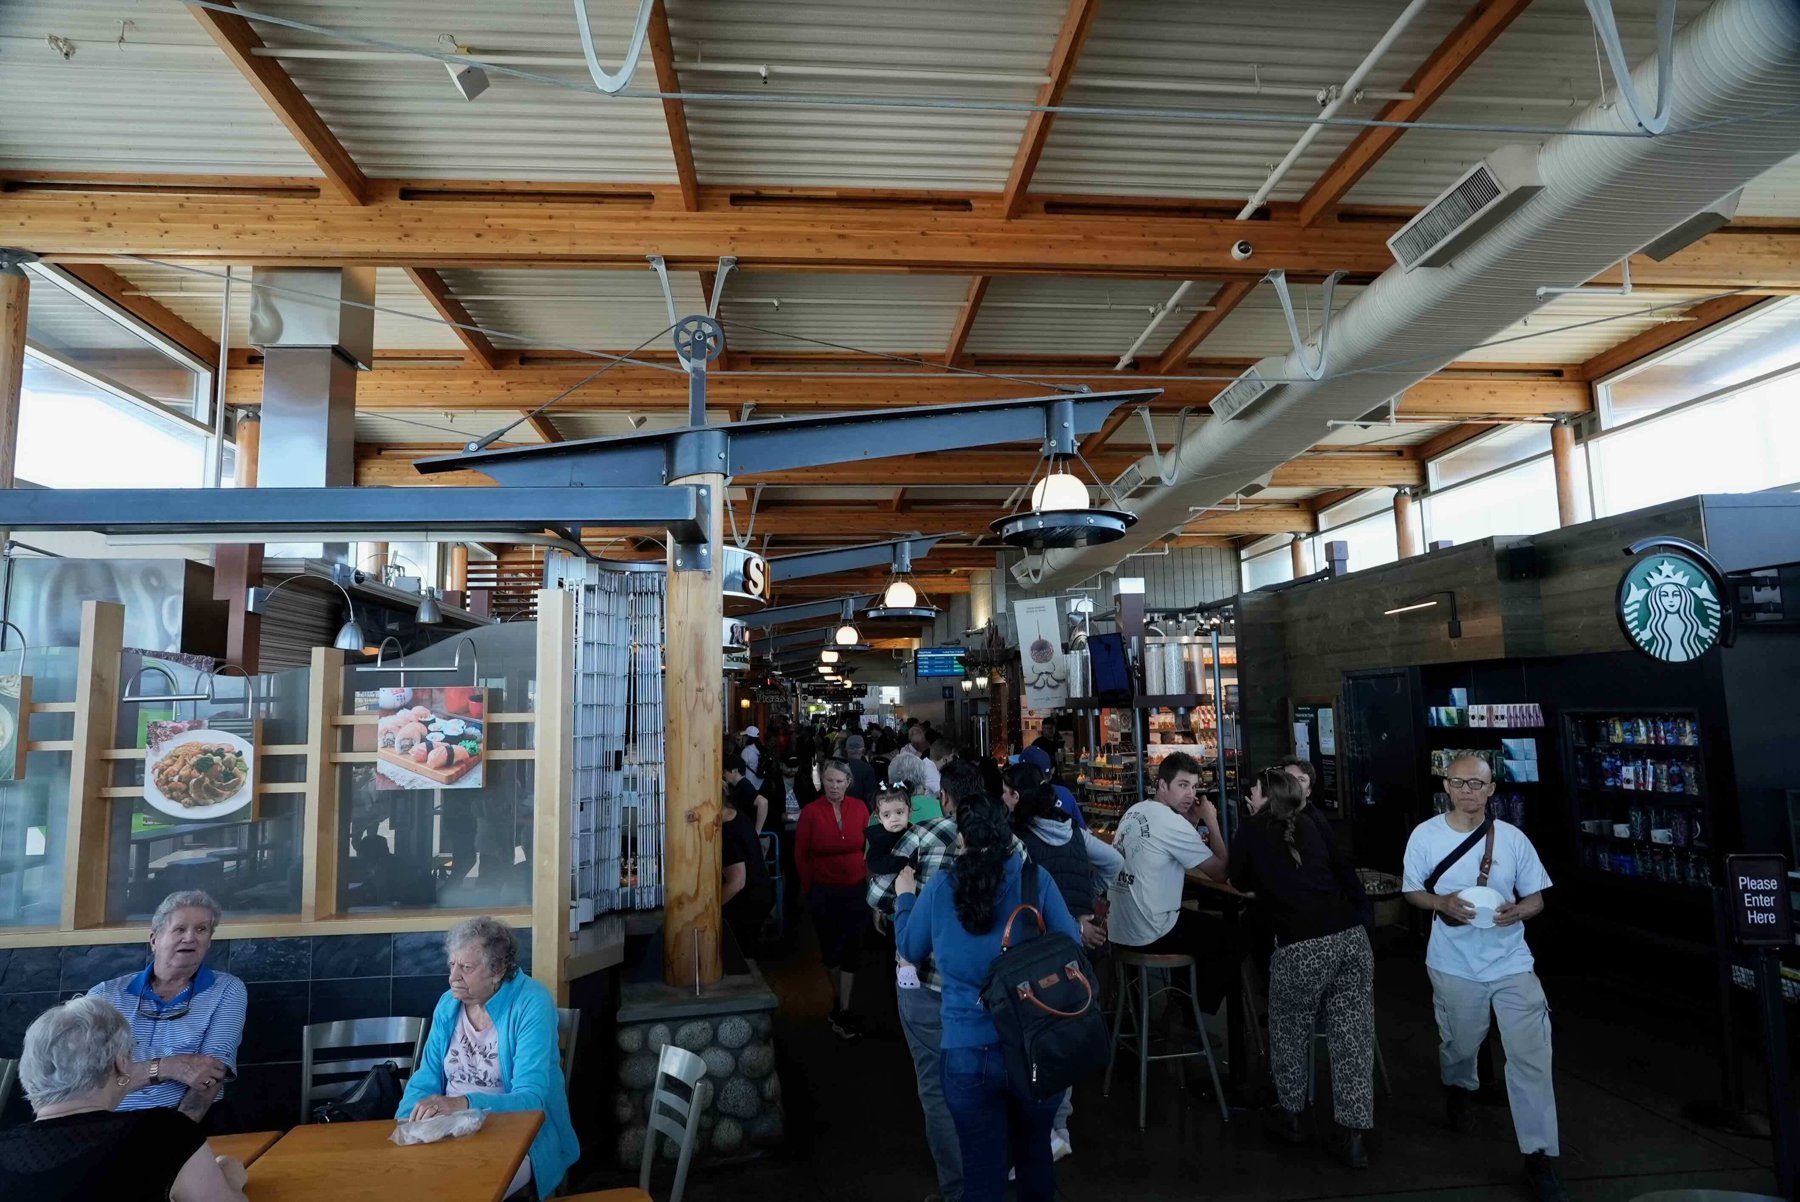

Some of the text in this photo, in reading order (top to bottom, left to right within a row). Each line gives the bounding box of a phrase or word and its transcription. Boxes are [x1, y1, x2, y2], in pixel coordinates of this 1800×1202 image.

[1739, 876, 1777, 890] Please
[1744, 893, 1776, 907] Enter
[1747, 910, 1776, 924] Here
